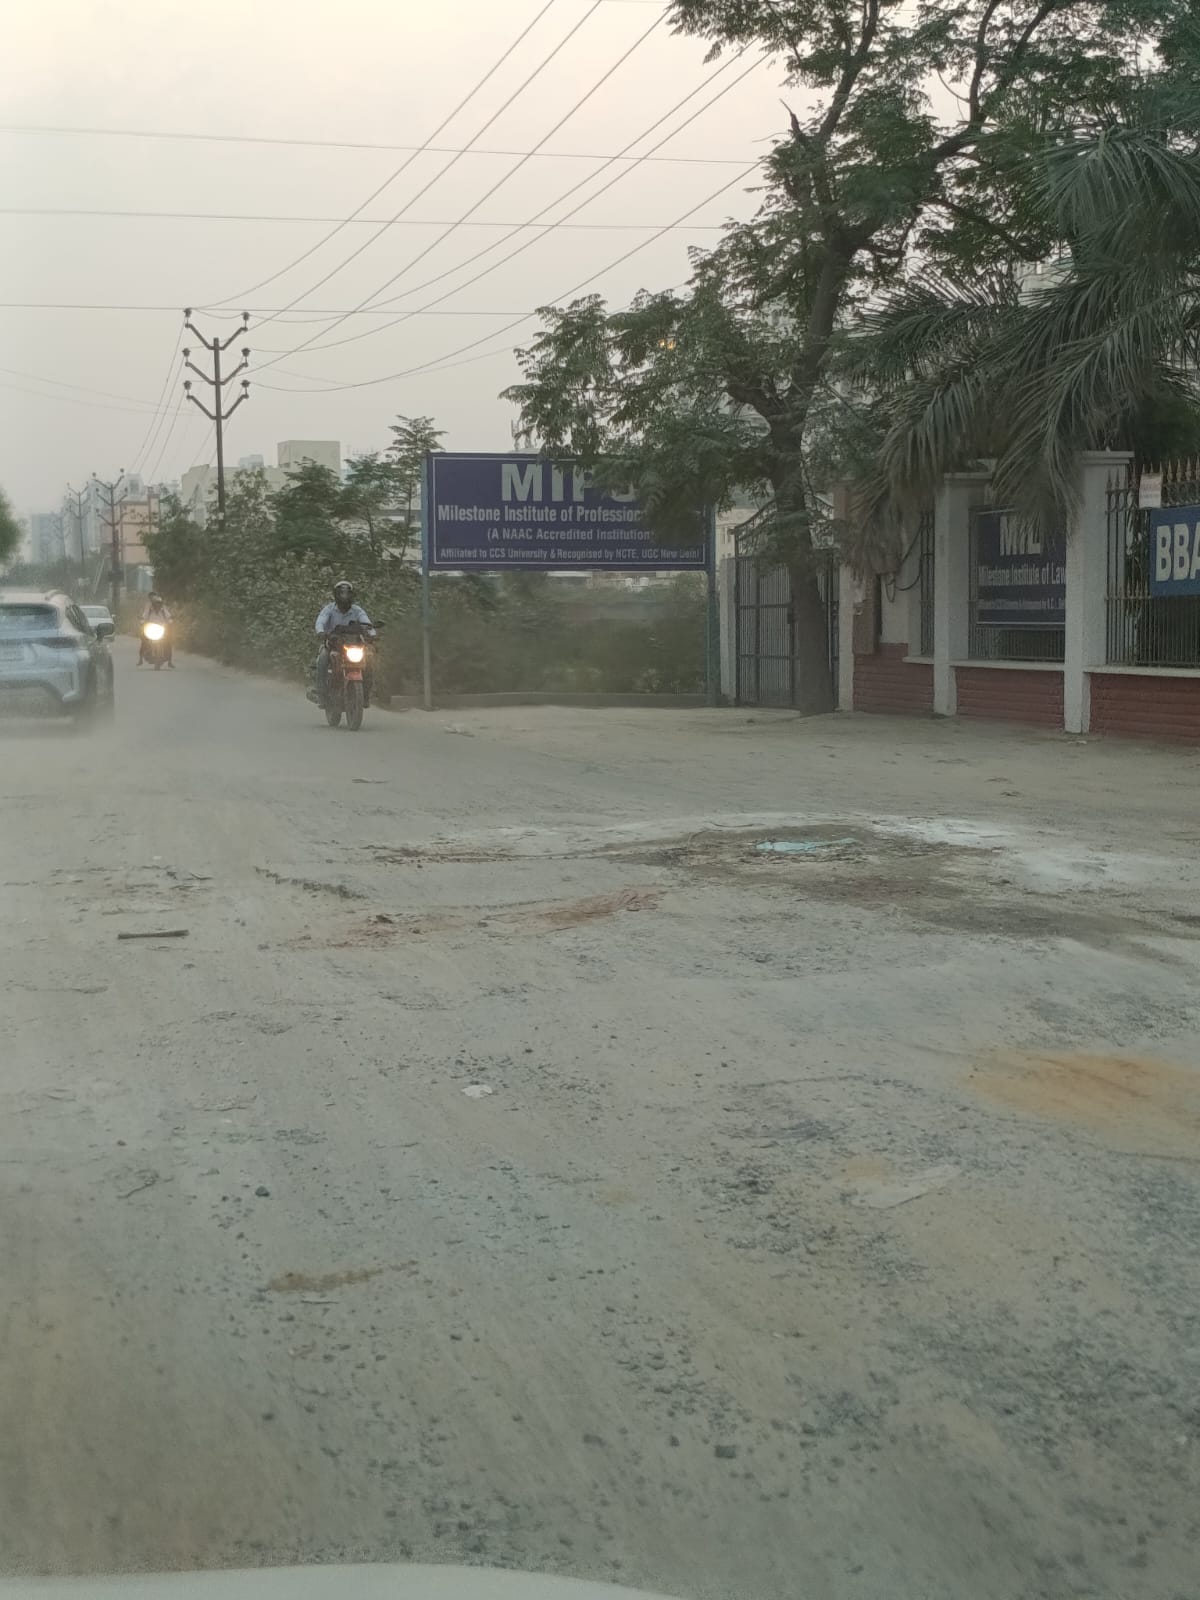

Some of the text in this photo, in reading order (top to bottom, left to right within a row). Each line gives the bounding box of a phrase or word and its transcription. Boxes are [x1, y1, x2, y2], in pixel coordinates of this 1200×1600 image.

[438, 504, 501, 522] Milestone
[504, 505, 557, 522] Institute
[560, 506, 573, 522] of
[487, 527, 499, 542] (A
[502, 528, 533, 541] NAAC
[536, 528, 593, 541] Accredited
[440, 547, 477, 559] Affiliated
[479, 548, 487, 559] to
[489, 547, 506, 559] CCS
[508, 547, 547, 560] University
[550, 548, 556, 560] &
[556, 548, 602, 561] Recognised
[604, 548, 614, 560] by
[641, 548, 659, 559] UGC
[1041, 561, 1050, 585] of
